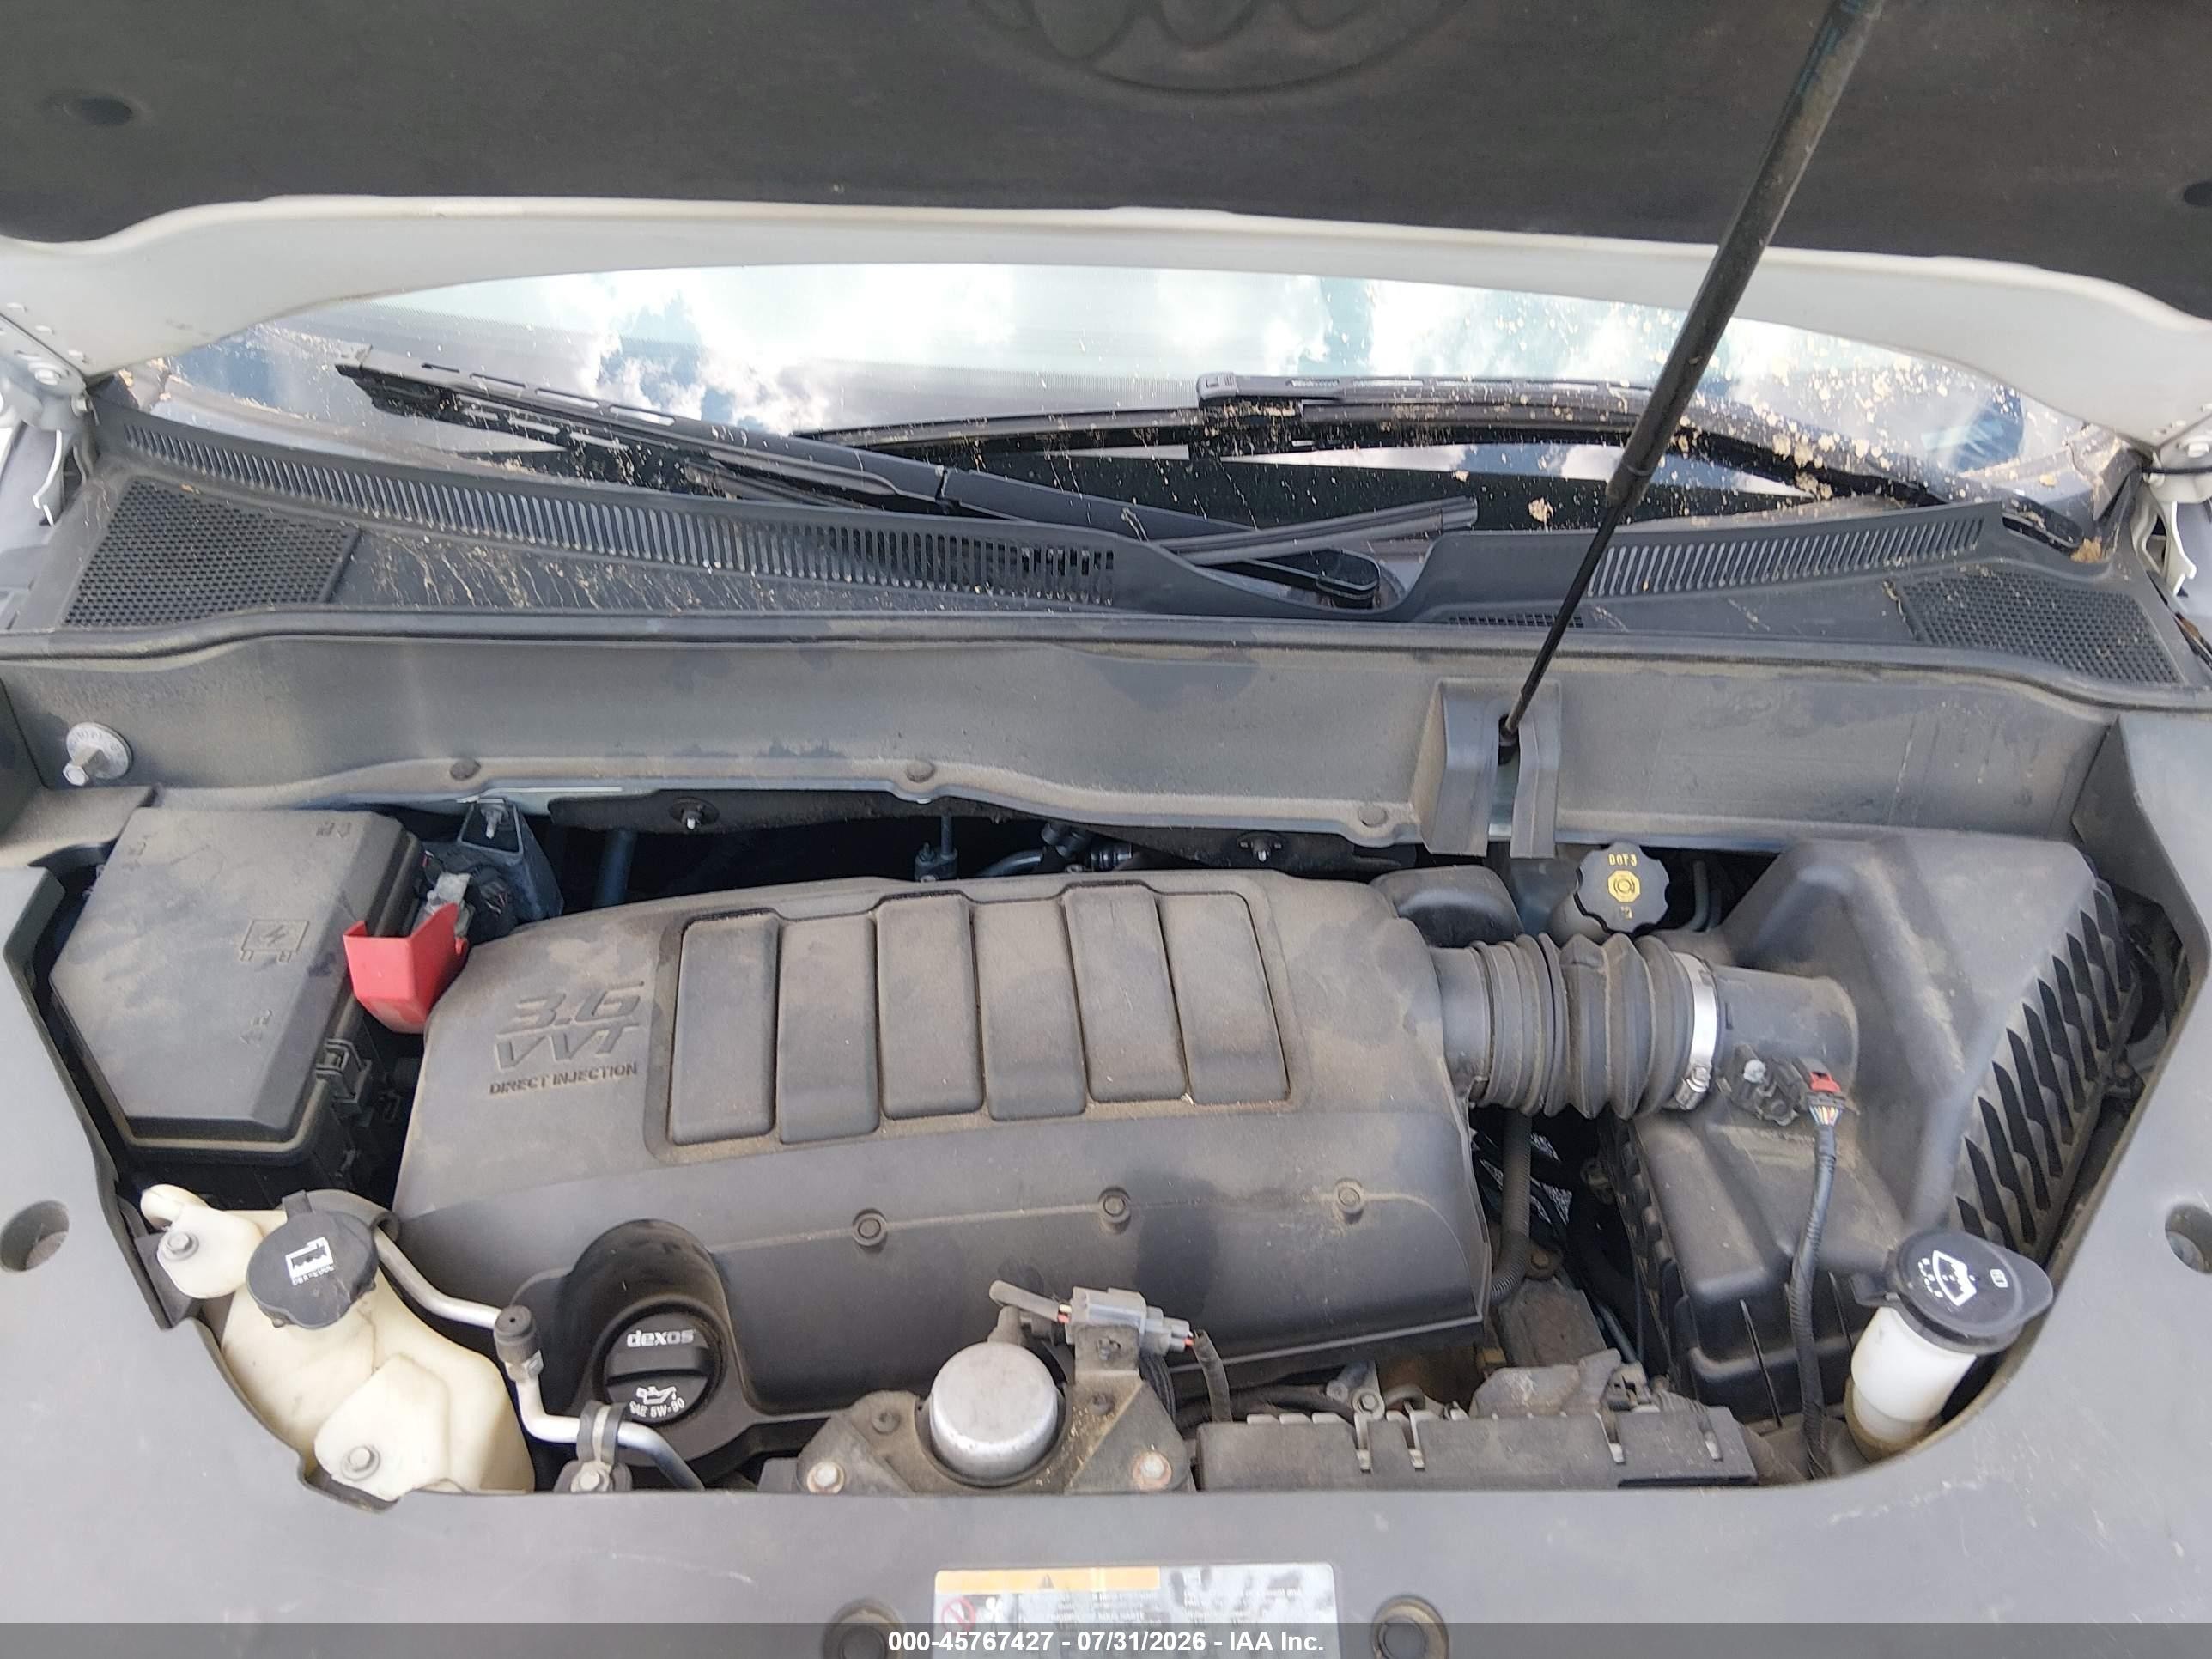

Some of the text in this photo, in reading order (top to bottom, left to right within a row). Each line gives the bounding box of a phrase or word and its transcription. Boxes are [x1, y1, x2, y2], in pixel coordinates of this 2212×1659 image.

[1608, 854, 1638, 866] DOT 3
[496, 981, 644, 1035] 3.6
[495, 1023, 640, 1070] VVT
[489, 1062, 638, 1095] DIRECT INJECTION
[626, 1329, 695, 1348] dexos
[629, 1401, 647, 1418] SAE
